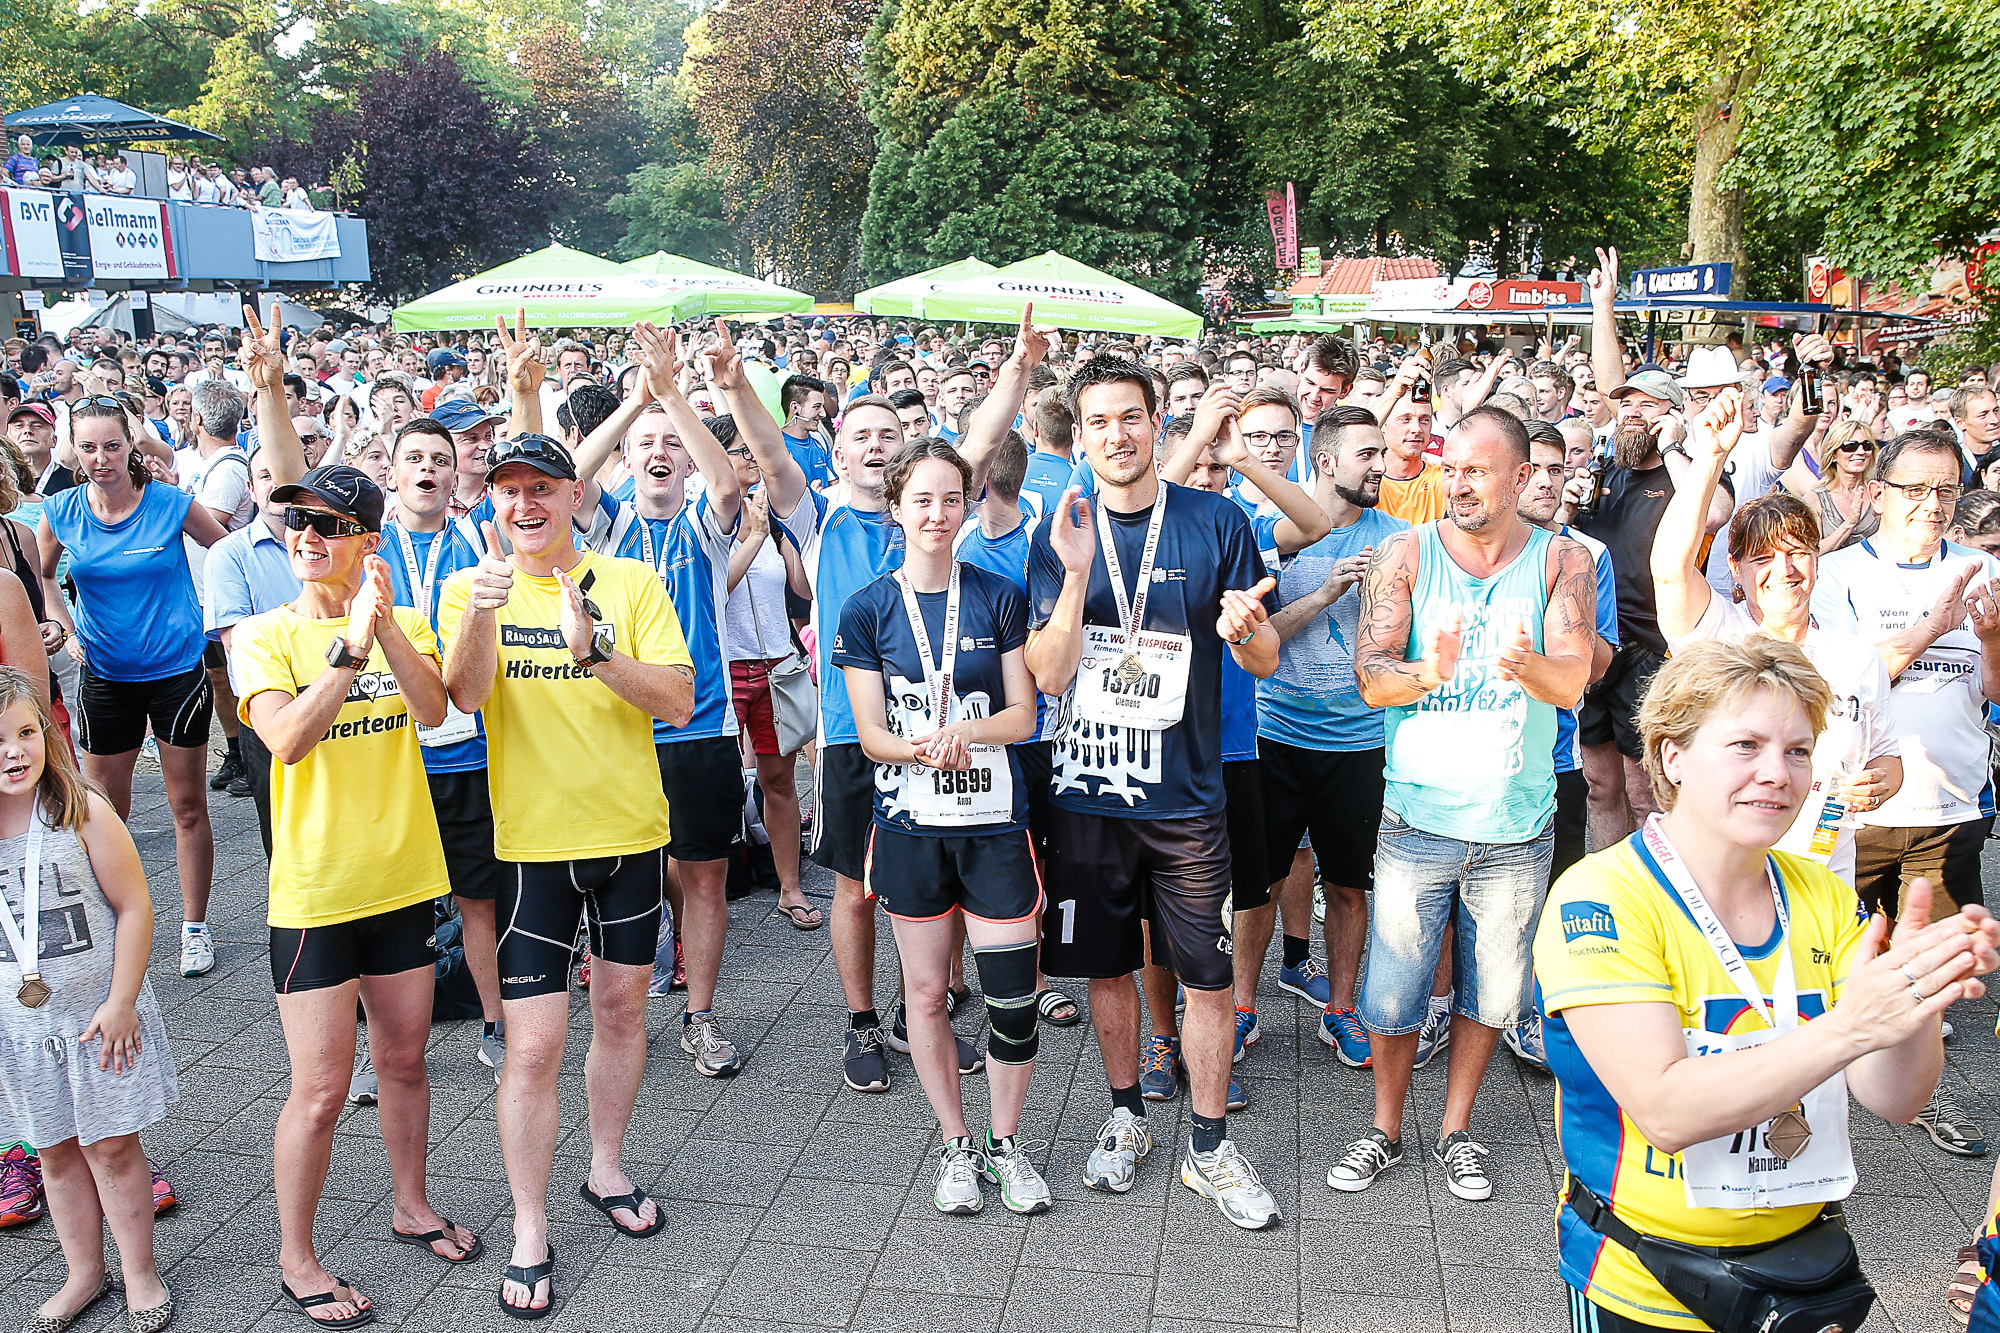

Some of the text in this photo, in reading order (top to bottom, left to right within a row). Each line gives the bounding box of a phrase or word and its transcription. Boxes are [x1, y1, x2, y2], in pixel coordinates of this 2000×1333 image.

[20, 201, 50, 222] BVT
[88, 207, 157, 229] Bellmann
[1648, 268, 1698, 294] KARLSBERG
[1508, 287, 1567, 305] Imbiss
[1880, 621, 1906, 630] rund
[1089, 632, 1183, 652] 11. WOENSPIEGEL
[1093, 644, 1124, 654] Firmenla
[505, 659, 594, 680] Hörertea
[1115, 696, 1141, 709] Clemens
[320, 712, 408, 741] rerteam
[967, 745, 988, 753] arland
[931, 767, 992, 795] 13699
[1058, 898, 1077, 944] 1
[1562, 911, 1611, 935] vitafit
[1705, 920, 1743, 974] WOCH
[1748, 1156, 1788, 1174] Manuela
